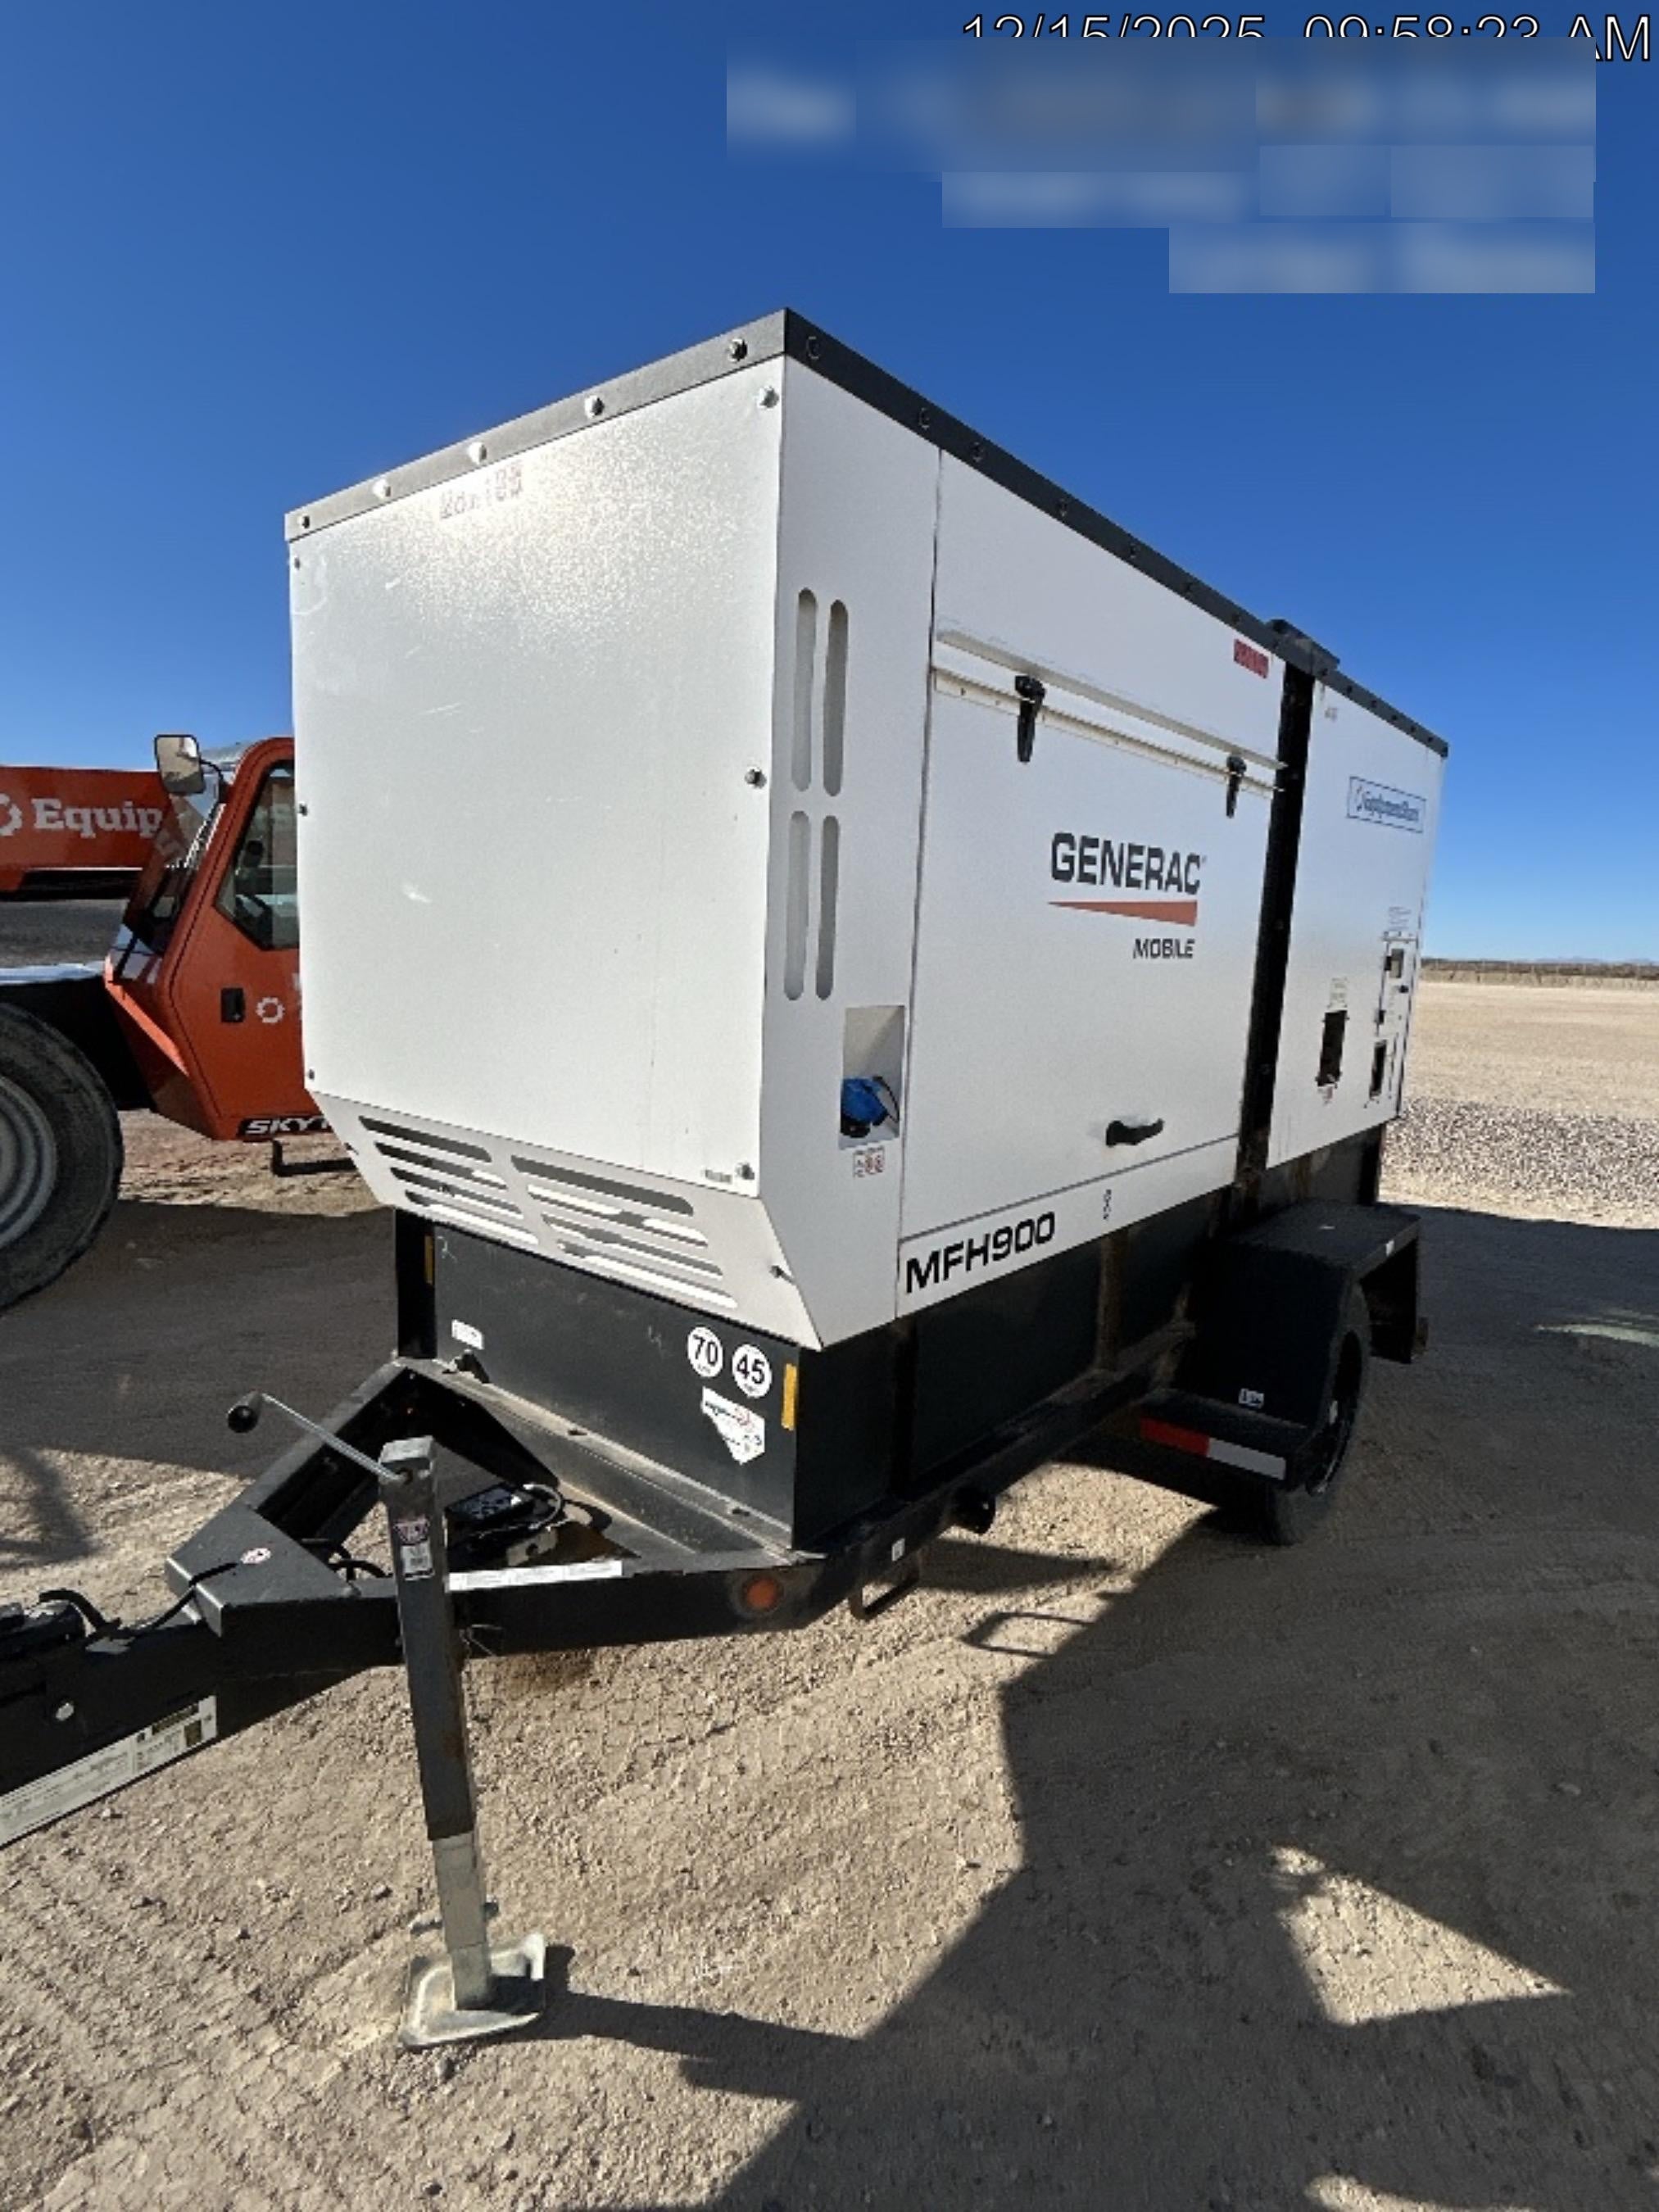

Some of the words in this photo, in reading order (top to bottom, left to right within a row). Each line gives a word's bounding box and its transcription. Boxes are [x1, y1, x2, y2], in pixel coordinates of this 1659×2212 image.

[1051, 832, 1200, 895] GENERAC
[1132, 938, 1195, 959] MOBILE
[905, 1211, 1055, 1294] MFH900
[692, 1334, 718, 1367] 70
[737, 1354, 765, 1385] 45
